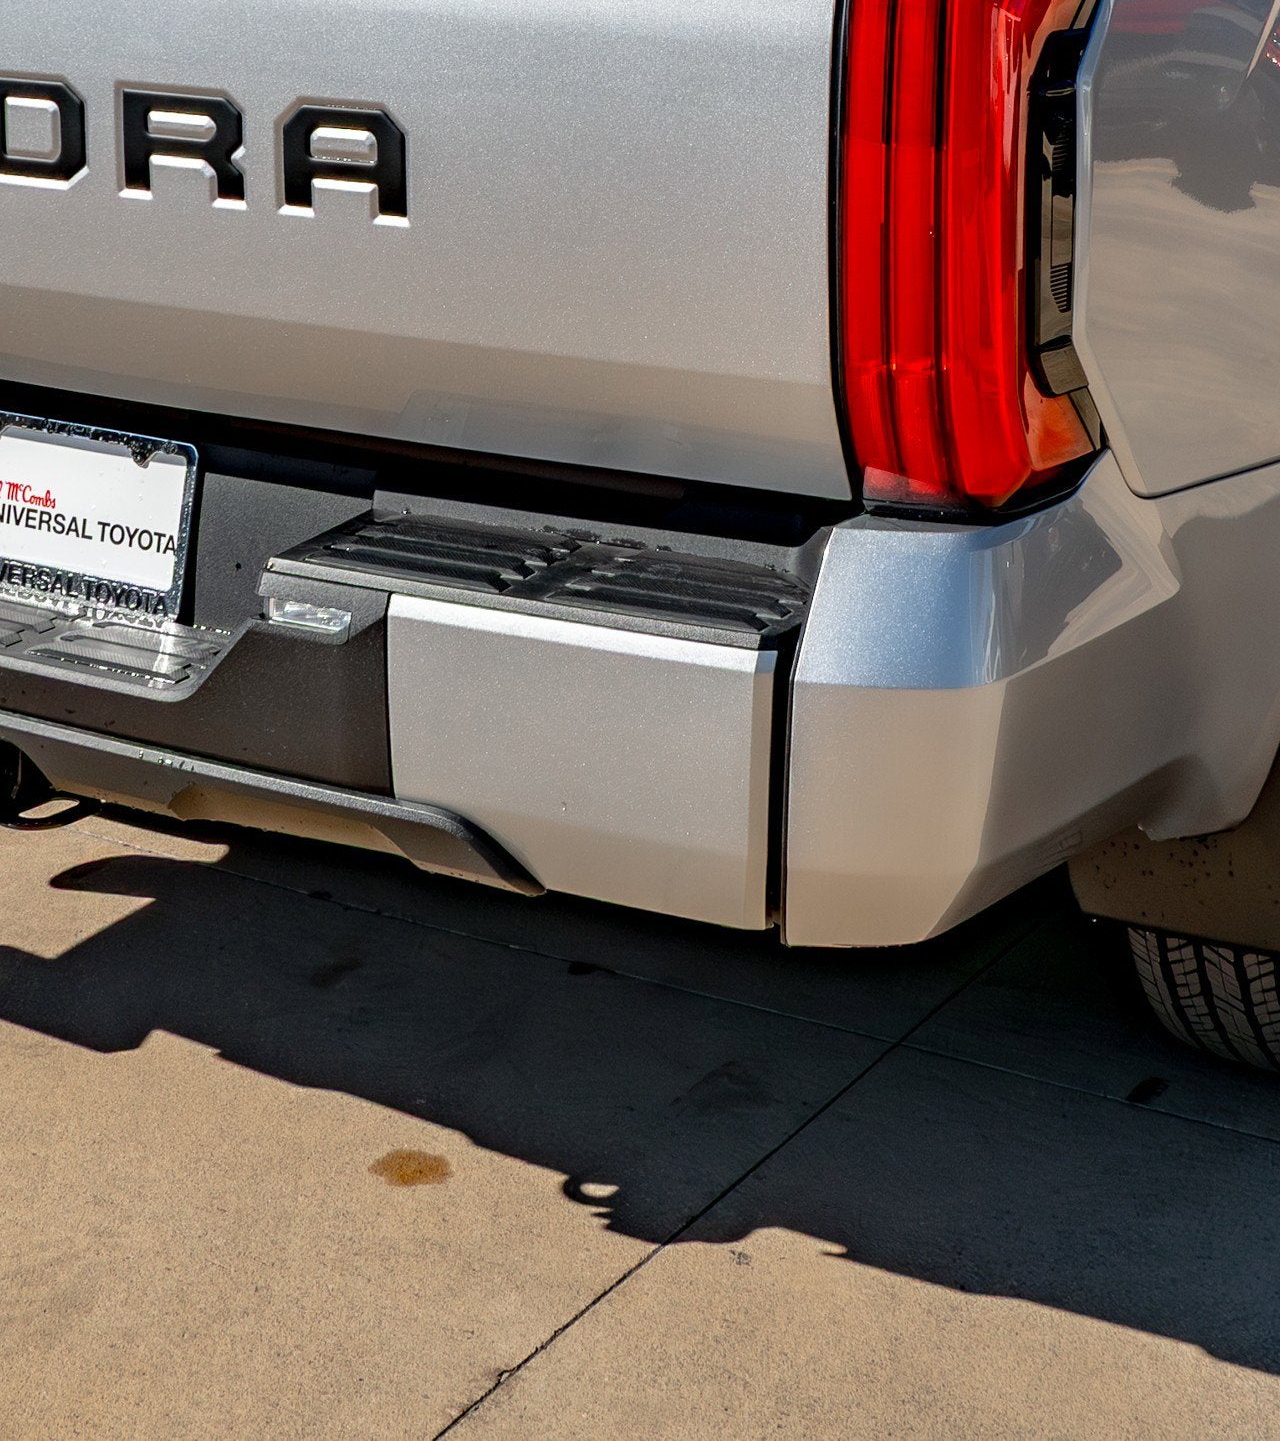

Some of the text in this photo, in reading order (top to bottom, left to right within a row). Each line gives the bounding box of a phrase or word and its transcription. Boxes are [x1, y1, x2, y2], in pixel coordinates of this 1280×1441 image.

[6, 481, 56, 509] McCombs
[97, 521, 177, 556] TOYOTA
[82, 578, 168, 615] TOYOTA
